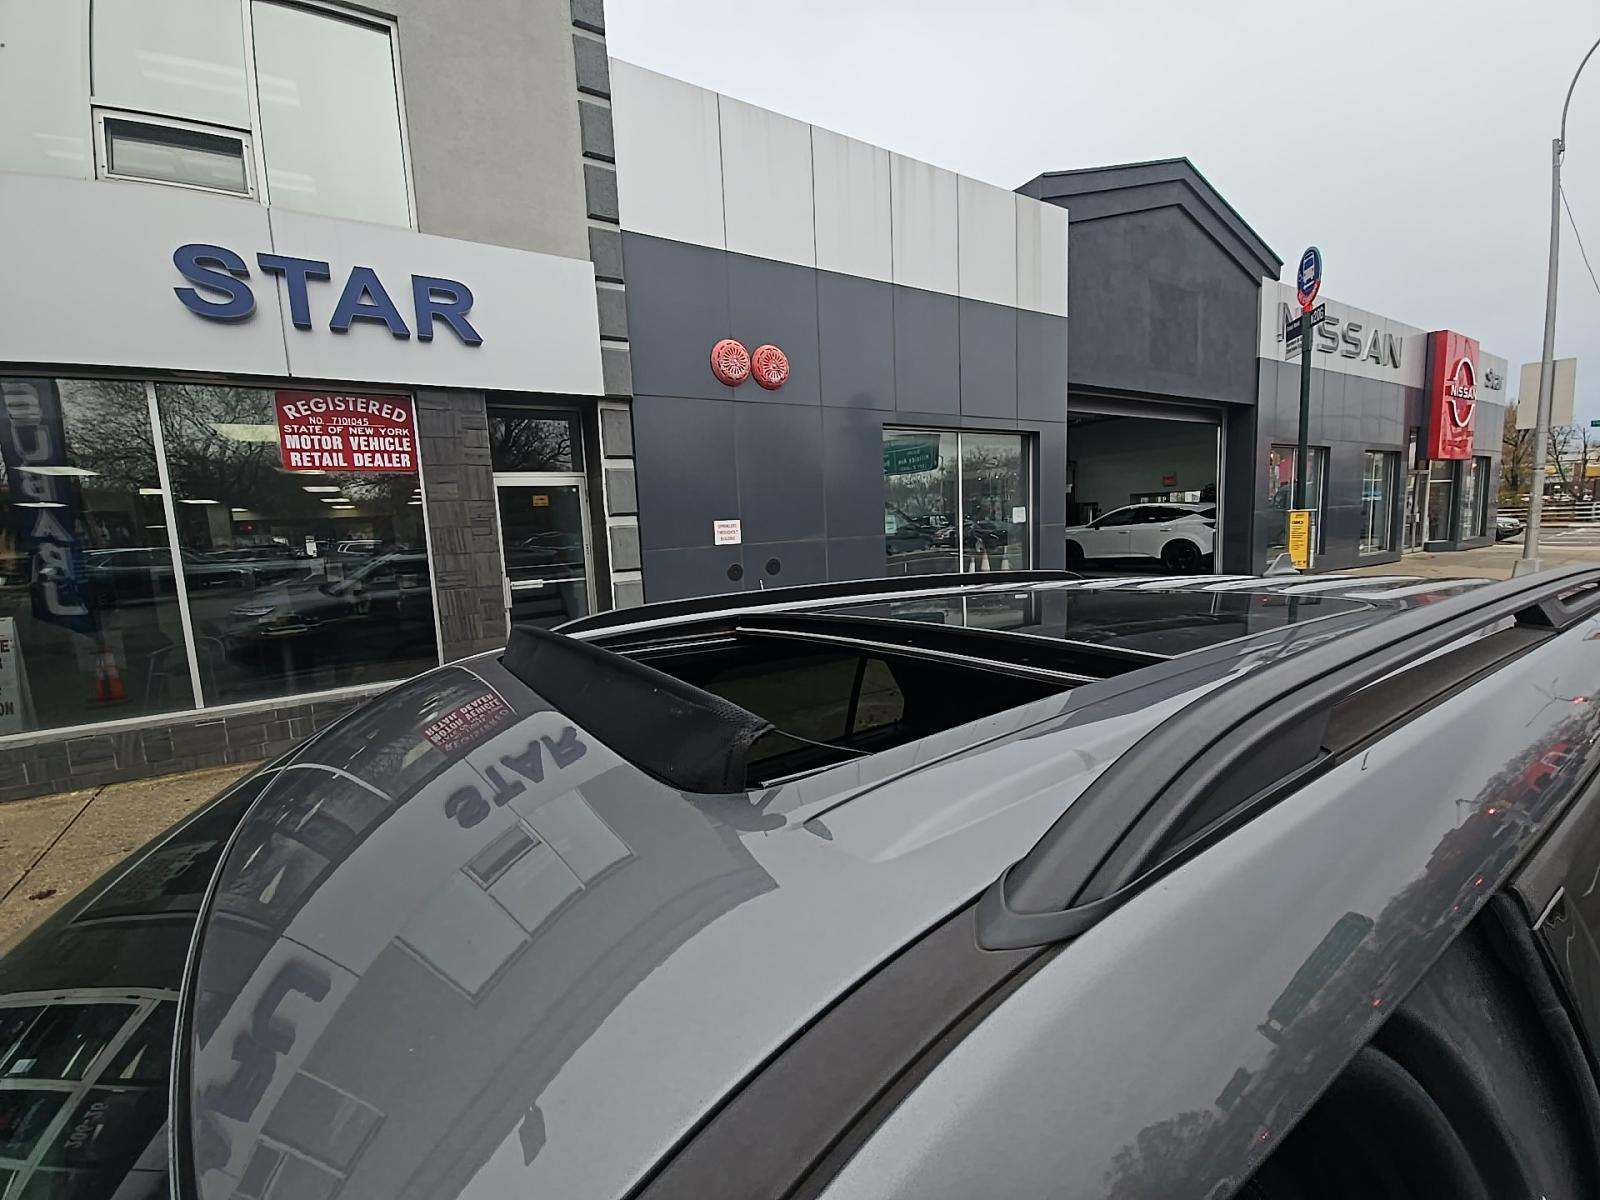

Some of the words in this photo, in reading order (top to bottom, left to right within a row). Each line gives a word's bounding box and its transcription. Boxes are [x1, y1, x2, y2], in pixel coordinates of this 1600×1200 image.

[172, 242, 484, 347] STAR
[1276, 301, 1403, 369] NSSAN
[1450, 384, 1477, 400] NISSAN
[282, 396, 407, 423] REGISTERED
[331, 416, 369, 425] 7101045
[283, 424, 323, 434] STATE
[328, 425, 344, 434] OF
[349, 426, 374, 435] NEW
[378, 427, 411, 436] YORK
[284, 434, 343, 450] MOTOR
[348, 435, 412, 451] VEHICLE
[290, 451, 349, 467] RETAIL
[353, 452, 411, 467] DEALER
